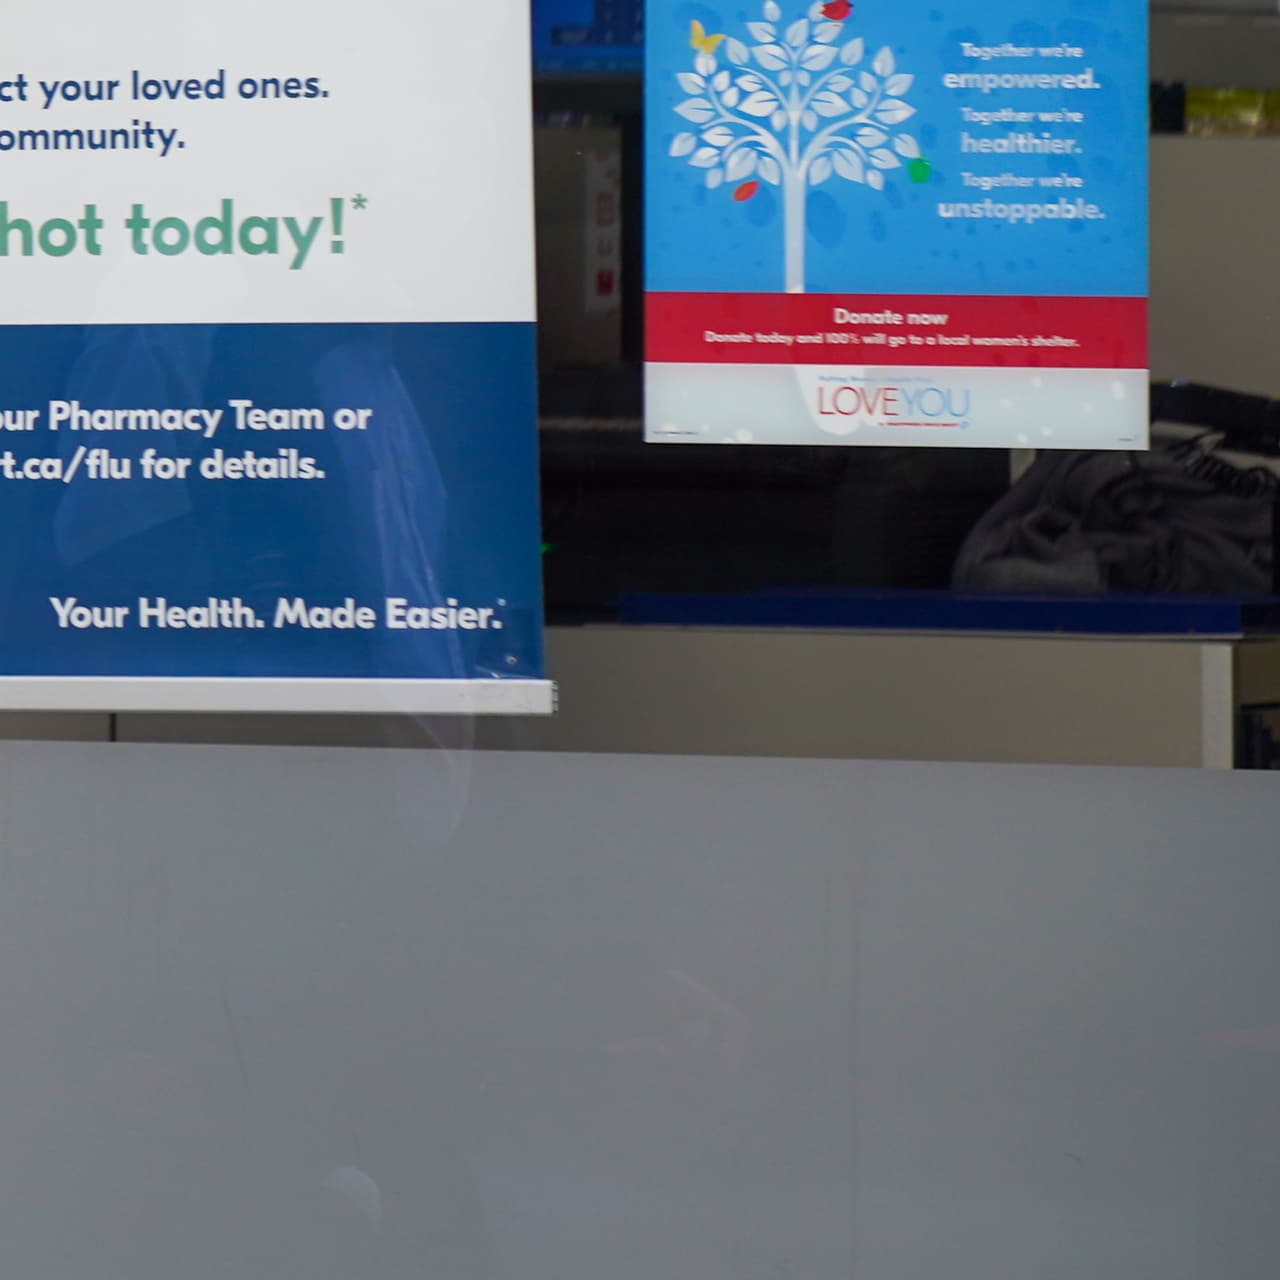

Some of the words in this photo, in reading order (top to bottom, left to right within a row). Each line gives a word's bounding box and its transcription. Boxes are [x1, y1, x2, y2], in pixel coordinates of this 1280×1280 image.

[959, 42, 1035, 61] Together
[39, 76, 121, 111] your
[131, 69, 226, 102] loved
[237, 73, 329, 100] ones.
[943, 67, 1102, 94] empowered.
[959, 106, 1035, 126] Together
[960, 131, 1084, 154] healthier.
[959, 171, 1035, 191] Together
[937, 197, 1108, 224] unstoppable.
[834, 307, 904, 325] Donate
[905, 313, 949, 326] now
[48, 400, 224, 438] Pharmacy
[228, 399, 325, 431] Team
[333, 408, 373, 431] or
[141, 449, 192, 480] for
[199, 448, 326, 480] details.
[49, 597, 129, 629] Your
[139, 597, 265, 629] Health.
[273, 597, 376, 629] Made
